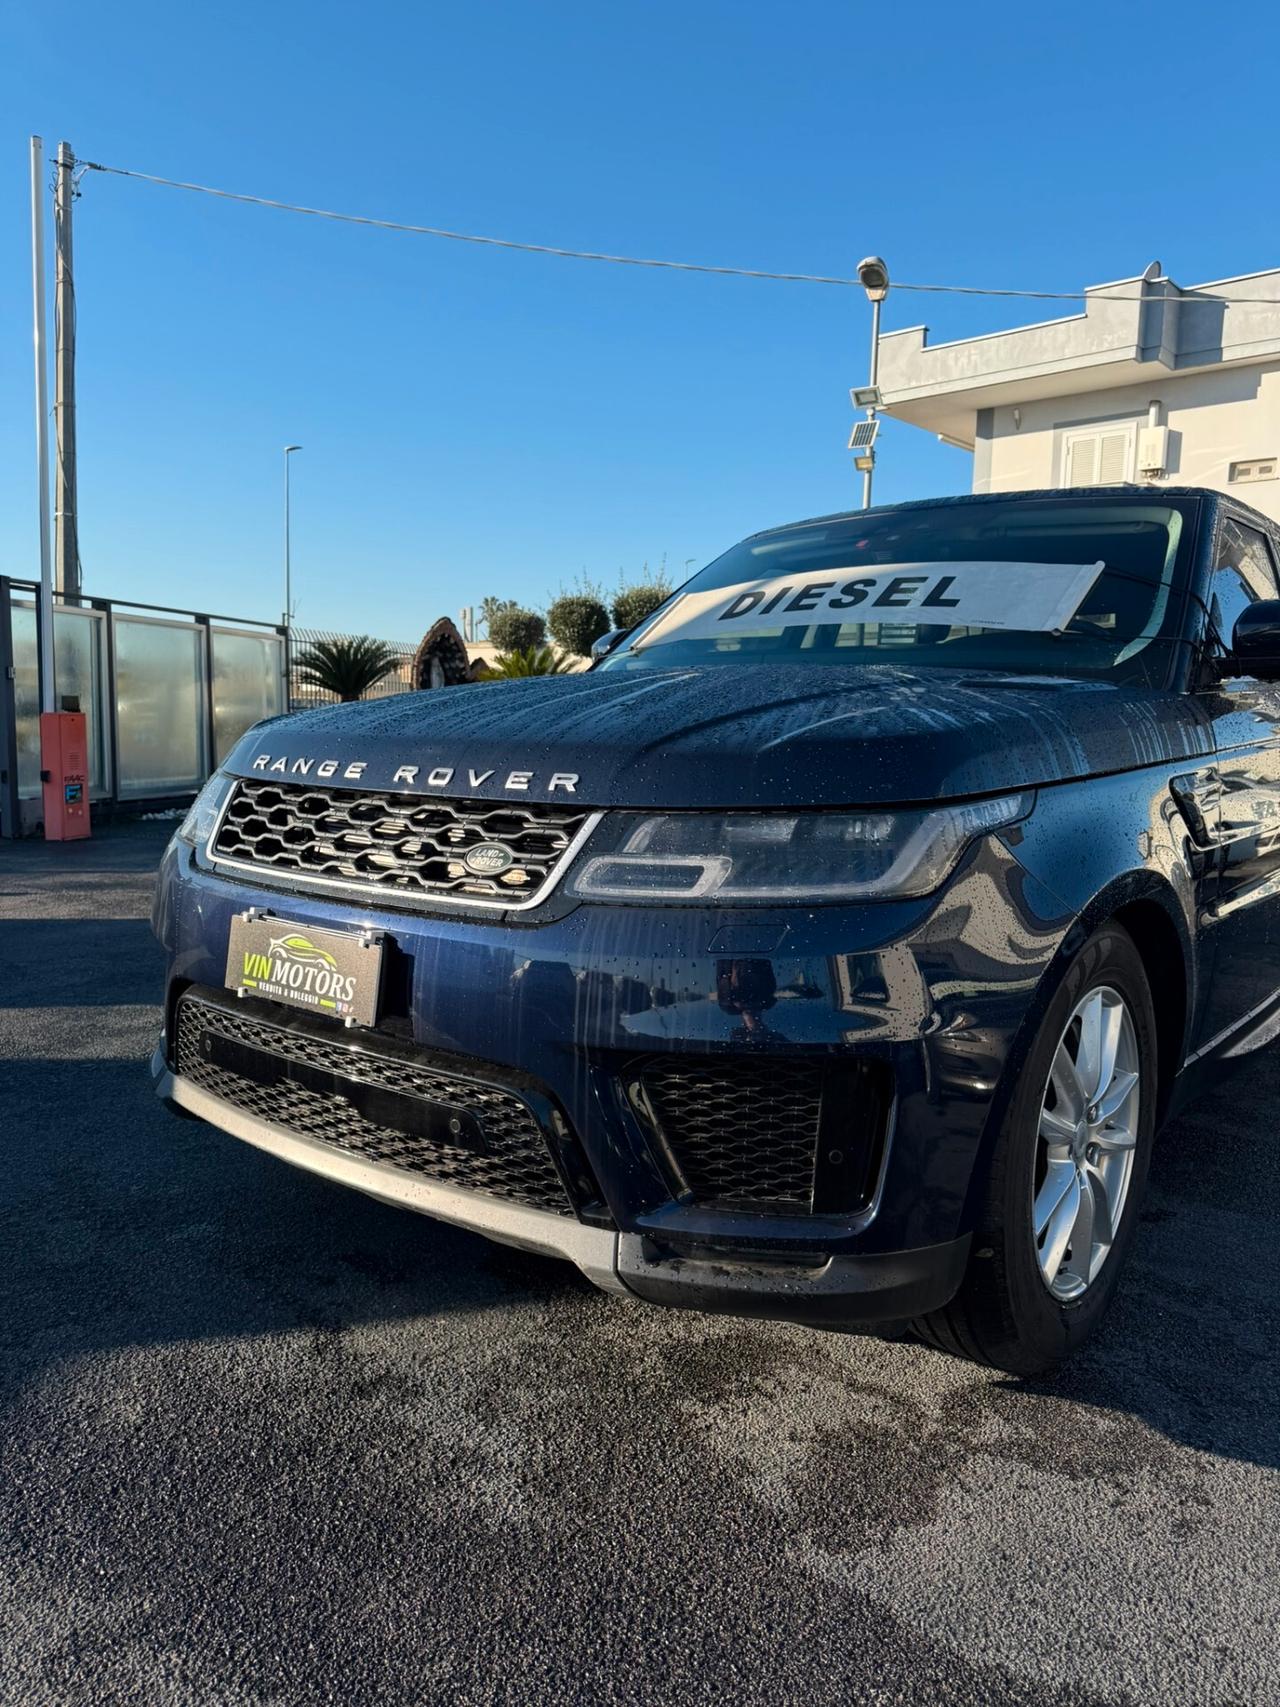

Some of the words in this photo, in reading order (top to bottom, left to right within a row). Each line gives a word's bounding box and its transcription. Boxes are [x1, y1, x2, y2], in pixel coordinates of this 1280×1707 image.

[719, 575, 962, 621] DIESEL
[253, 755, 368, 779] RANGE
[393, 765, 580, 793] ROVER
[475, 858, 503, 866] ROVER
[476, 849, 499, 857] LAND
[243, 952, 272, 979] VIN
[271, 960, 357, 1001] MOTORS
[259, 981, 282, 995] VENDITA
[290, 989, 319, 1005] NOLEGGIO
